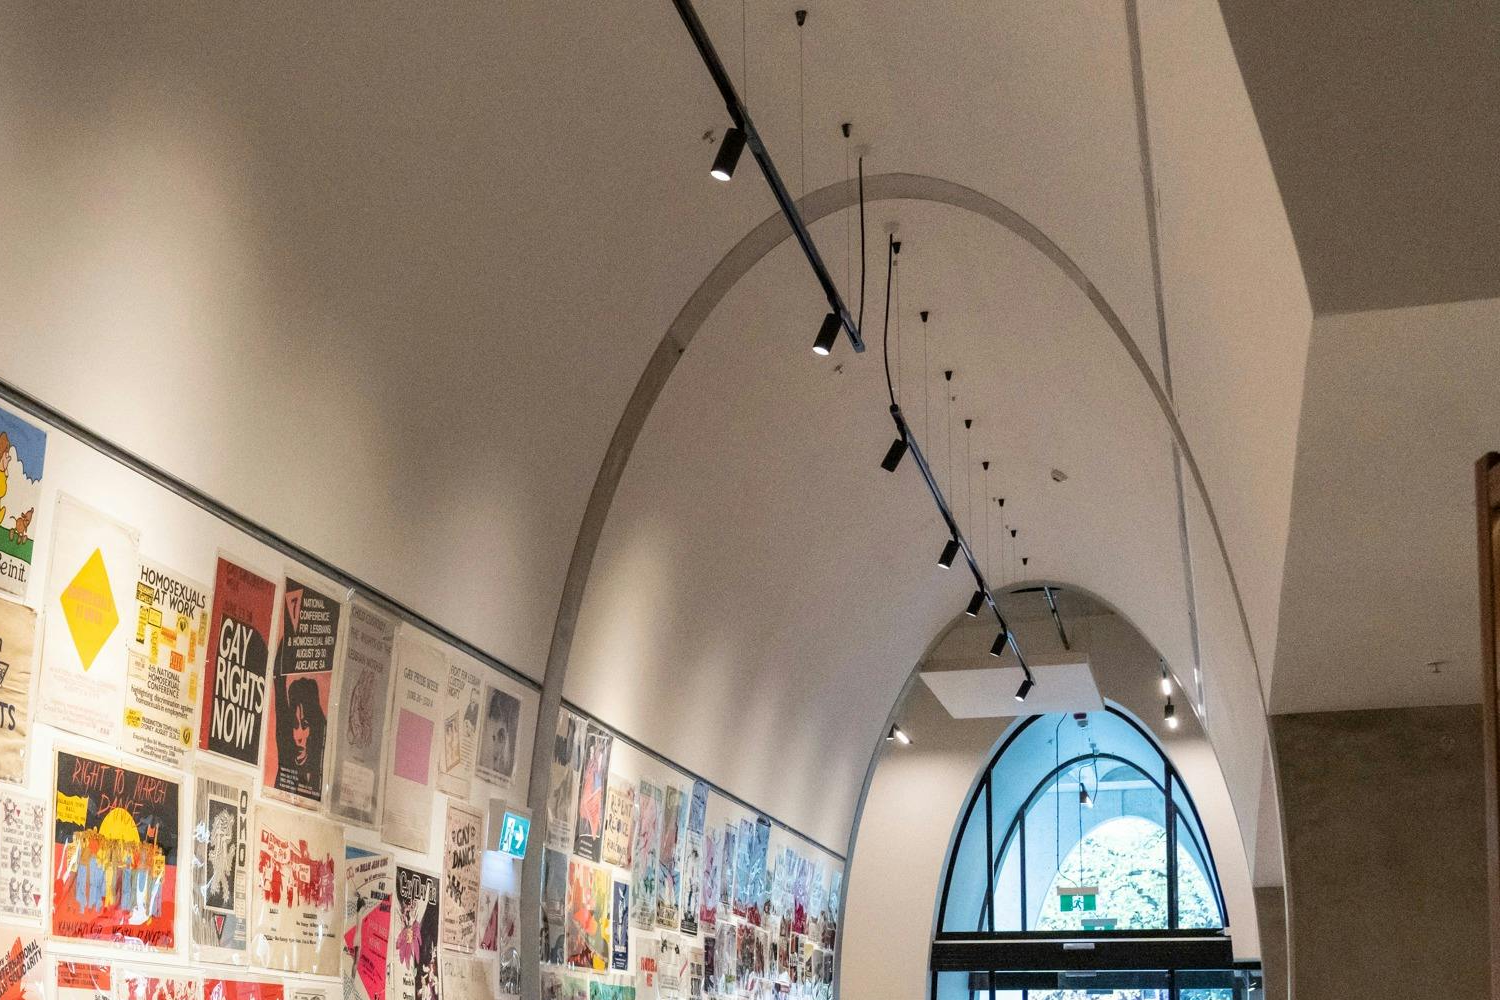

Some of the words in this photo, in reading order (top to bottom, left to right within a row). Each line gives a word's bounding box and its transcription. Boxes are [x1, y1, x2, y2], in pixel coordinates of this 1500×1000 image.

[141, 565, 206, 609] HOMOSEXUALS
[153, 590, 168, 604] AT
[169, 594, 195, 620] WORK
[218, 618, 253, 664] GAY
[215, 664, 265, 714] RIGHTS
[72, 759, 109, 792] RIGHT
[134, 775, 167, 804] MARCH
[456, 823, 471, 846] GAY
